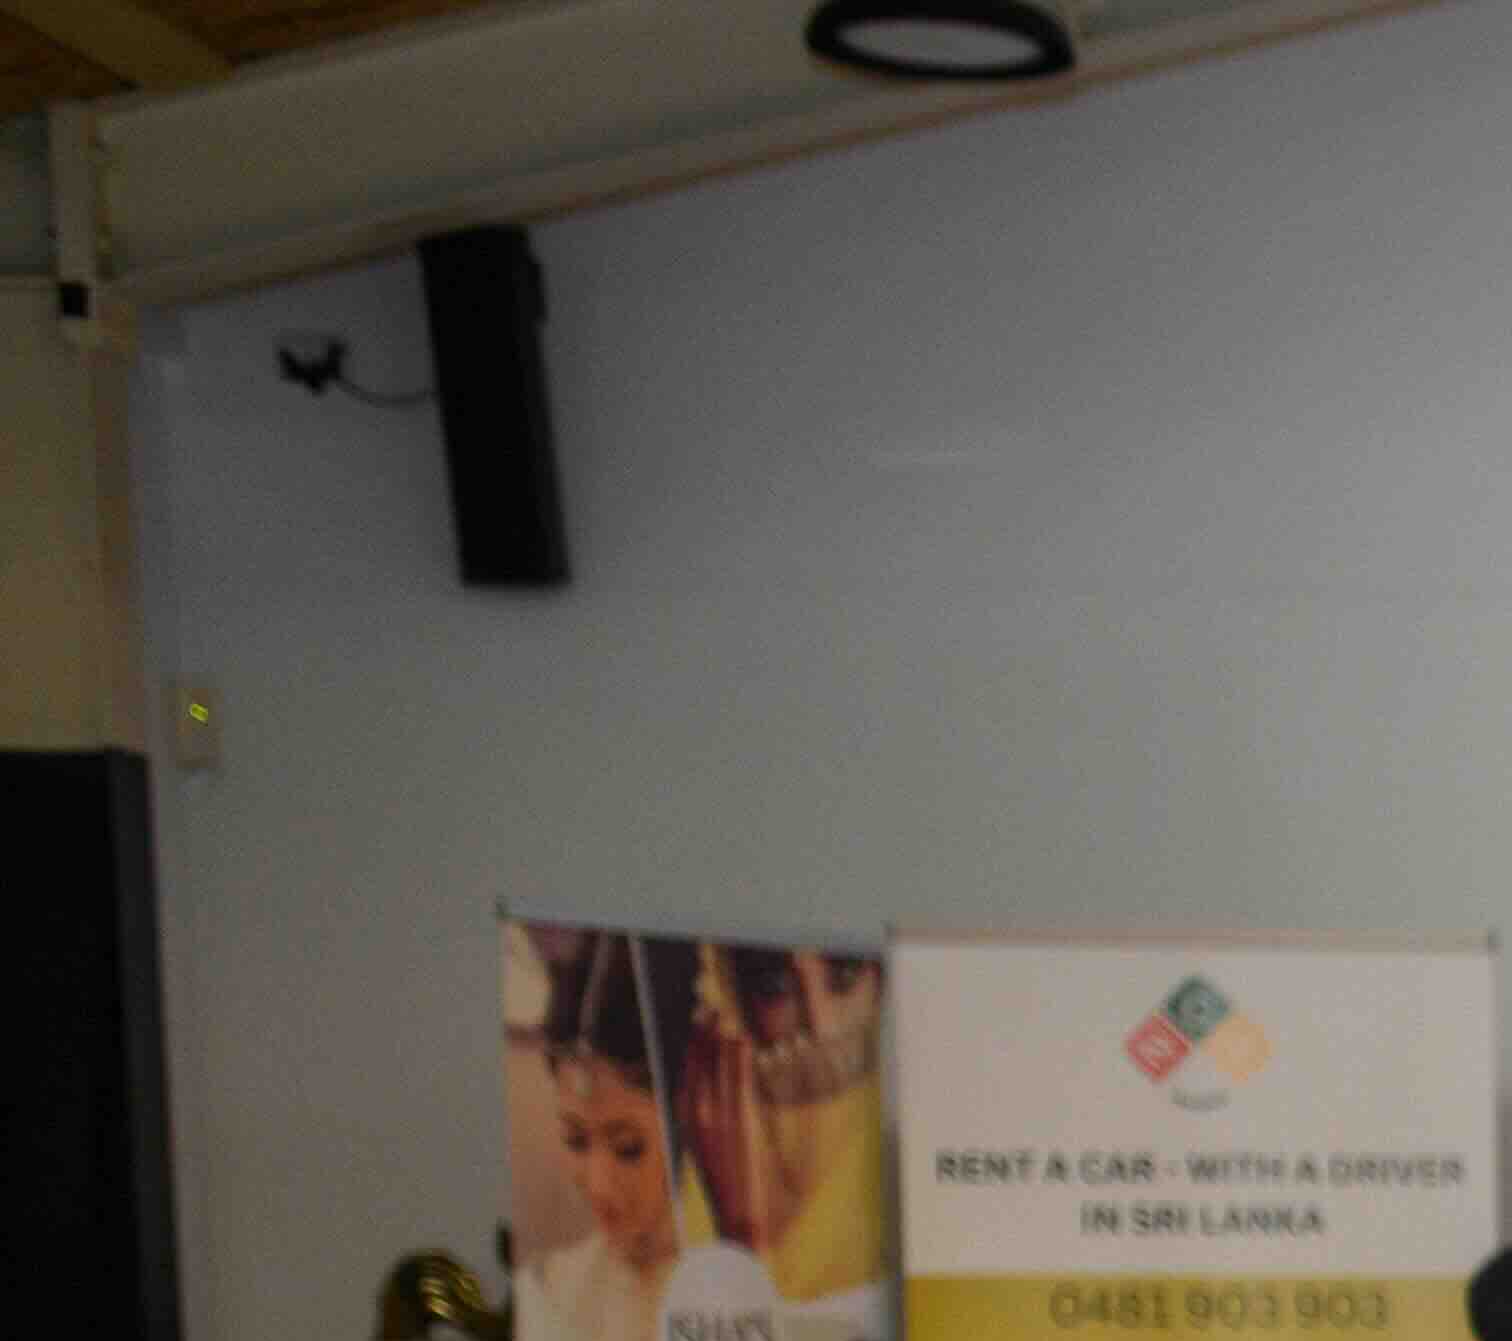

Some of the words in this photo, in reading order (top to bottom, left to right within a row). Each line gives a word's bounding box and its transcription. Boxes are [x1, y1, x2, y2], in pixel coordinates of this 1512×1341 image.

[936, 1151, 1035, 1184] RENT
[1045, 1151, 1068, 1184] A
[1079, 1151, 1156, 1185] CAR
[1187, 1151, 1285, 1186] WITH
[1295, 1152, 1319, 1186] A
[1330, 1152, 1466, 1186] DRIVER
[1081, 1204, 1118, 1235] IN
[1132, 1204, 1188, 1236] SRI
[1201, 1204, 1325, 1236] LANKA
[1050, 1286, 1173, 1331] 0481
[1184, 1286, 1279, 1331] 903
[1297, 1286, 1389, 1331] 903
